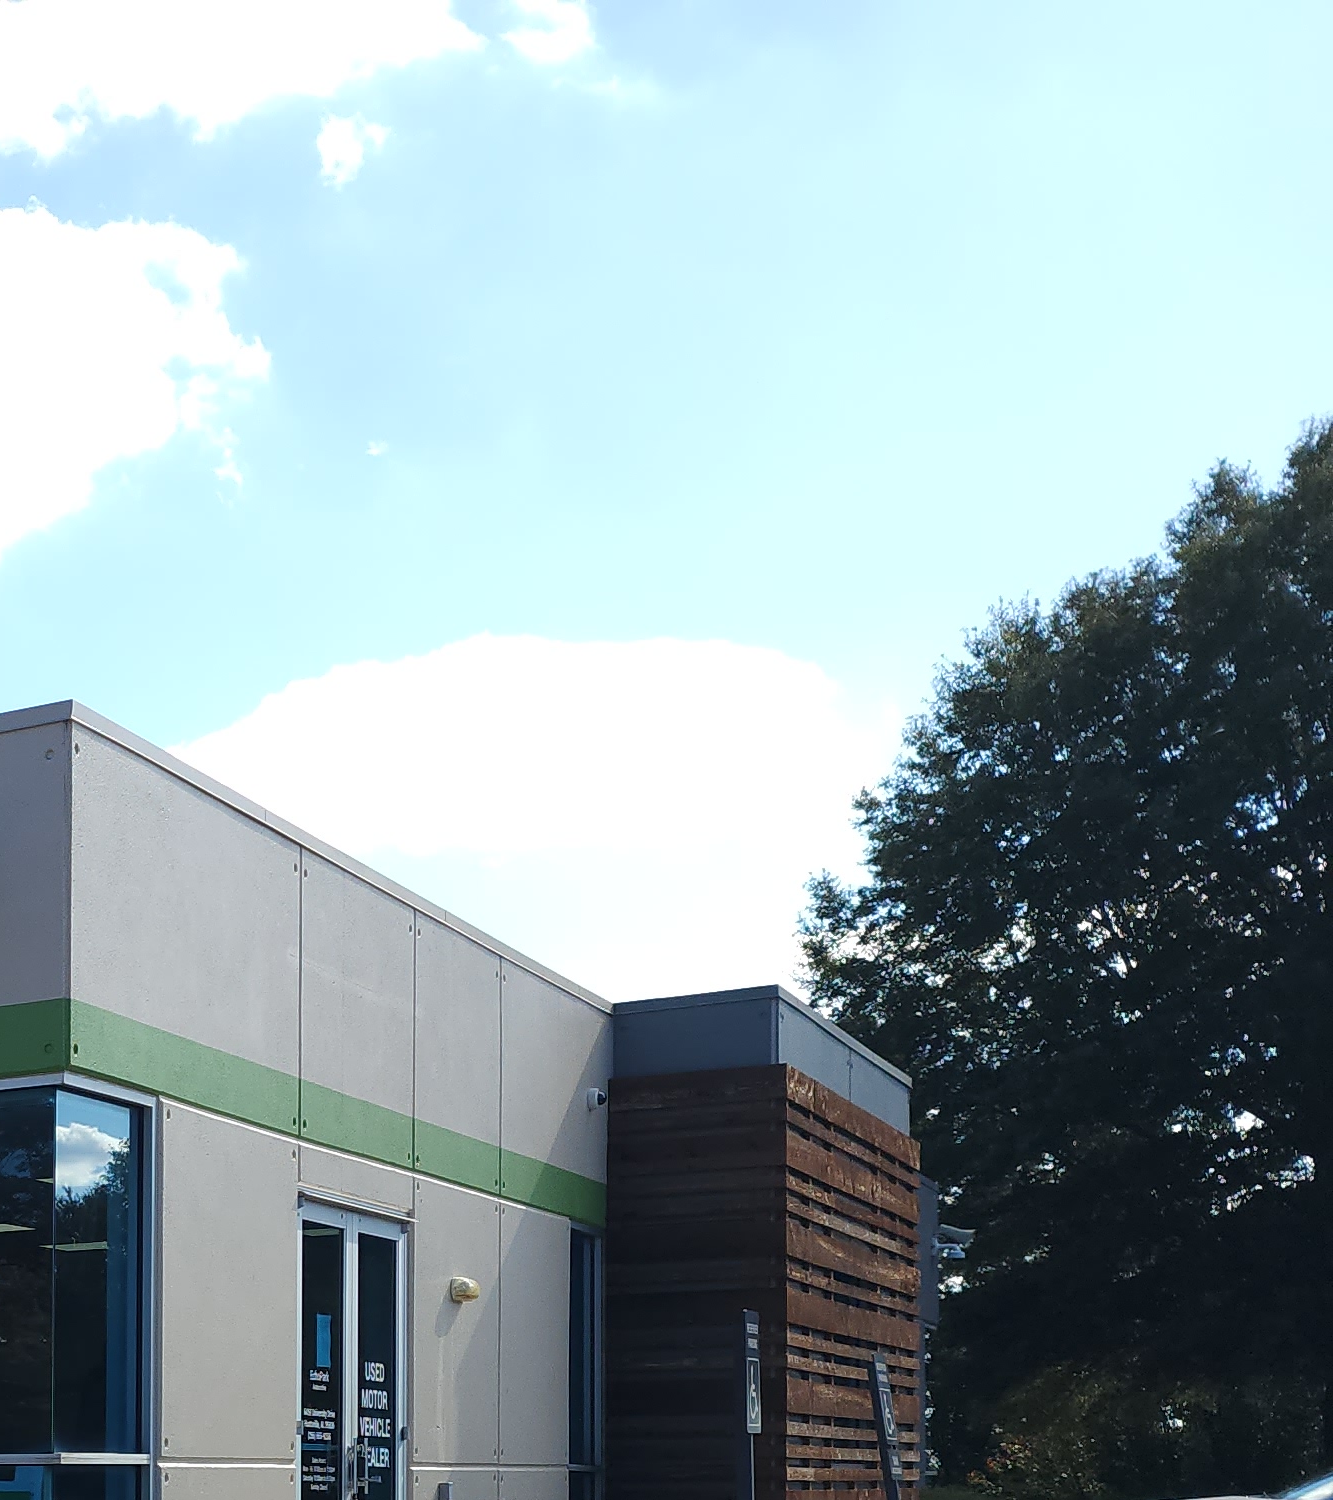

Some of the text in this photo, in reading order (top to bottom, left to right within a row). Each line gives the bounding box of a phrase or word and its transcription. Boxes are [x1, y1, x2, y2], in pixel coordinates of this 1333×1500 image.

[364, 1361, 385, 1383] USED
[361, 1388, 389, 1410] MOTOR
[359, 1416, 391, 1438] VEHICLE
[364, 1446, 391, 1469] EALER
